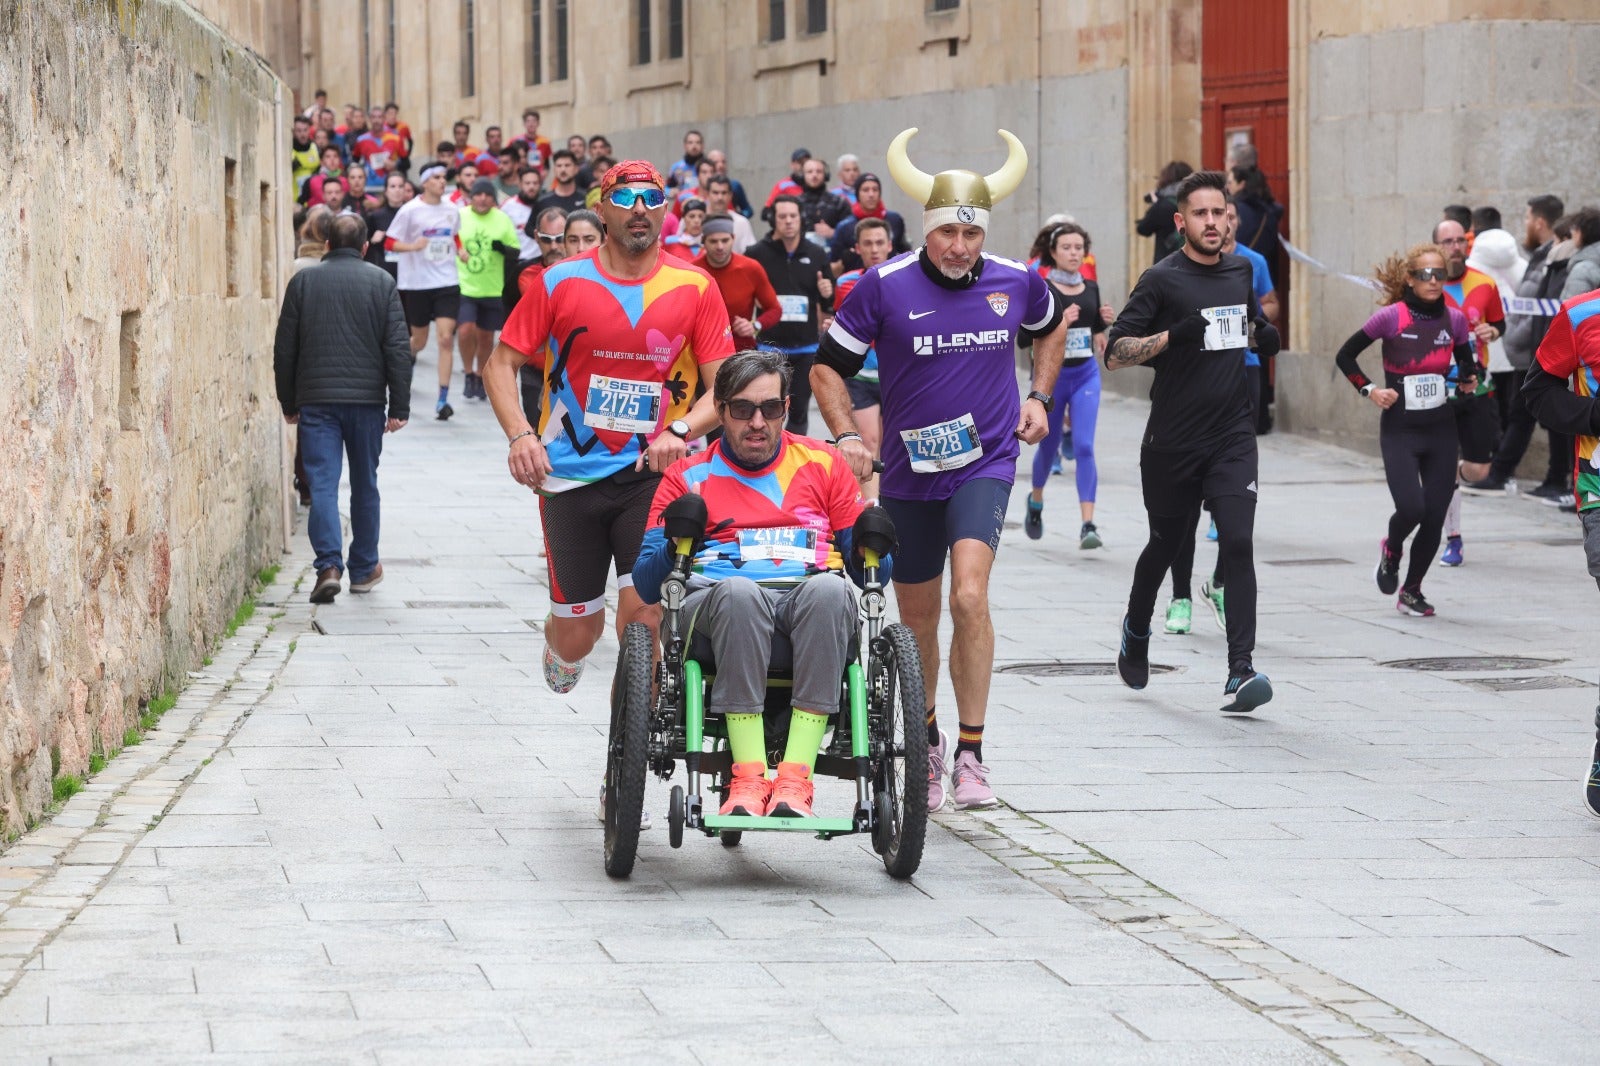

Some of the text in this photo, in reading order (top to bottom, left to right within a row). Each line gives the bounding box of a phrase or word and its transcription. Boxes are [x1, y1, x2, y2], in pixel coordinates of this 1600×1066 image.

[1215, 308, 1243, 316] SETEL
[1217, 318, 1230, 335] 711
[937, 329, 1009, 348] LENER
[593, 349, 604, 357] SAN
[605, 351, 634, 359] SILVESTRE
[609, 381, 655, 393] SETEL
[1415, 383, 1436, 397] 880
[599, 391, 640, 415] 2175
[920, 420, 967, 438] SETEL
[918, 433, 962, 457] 4228
